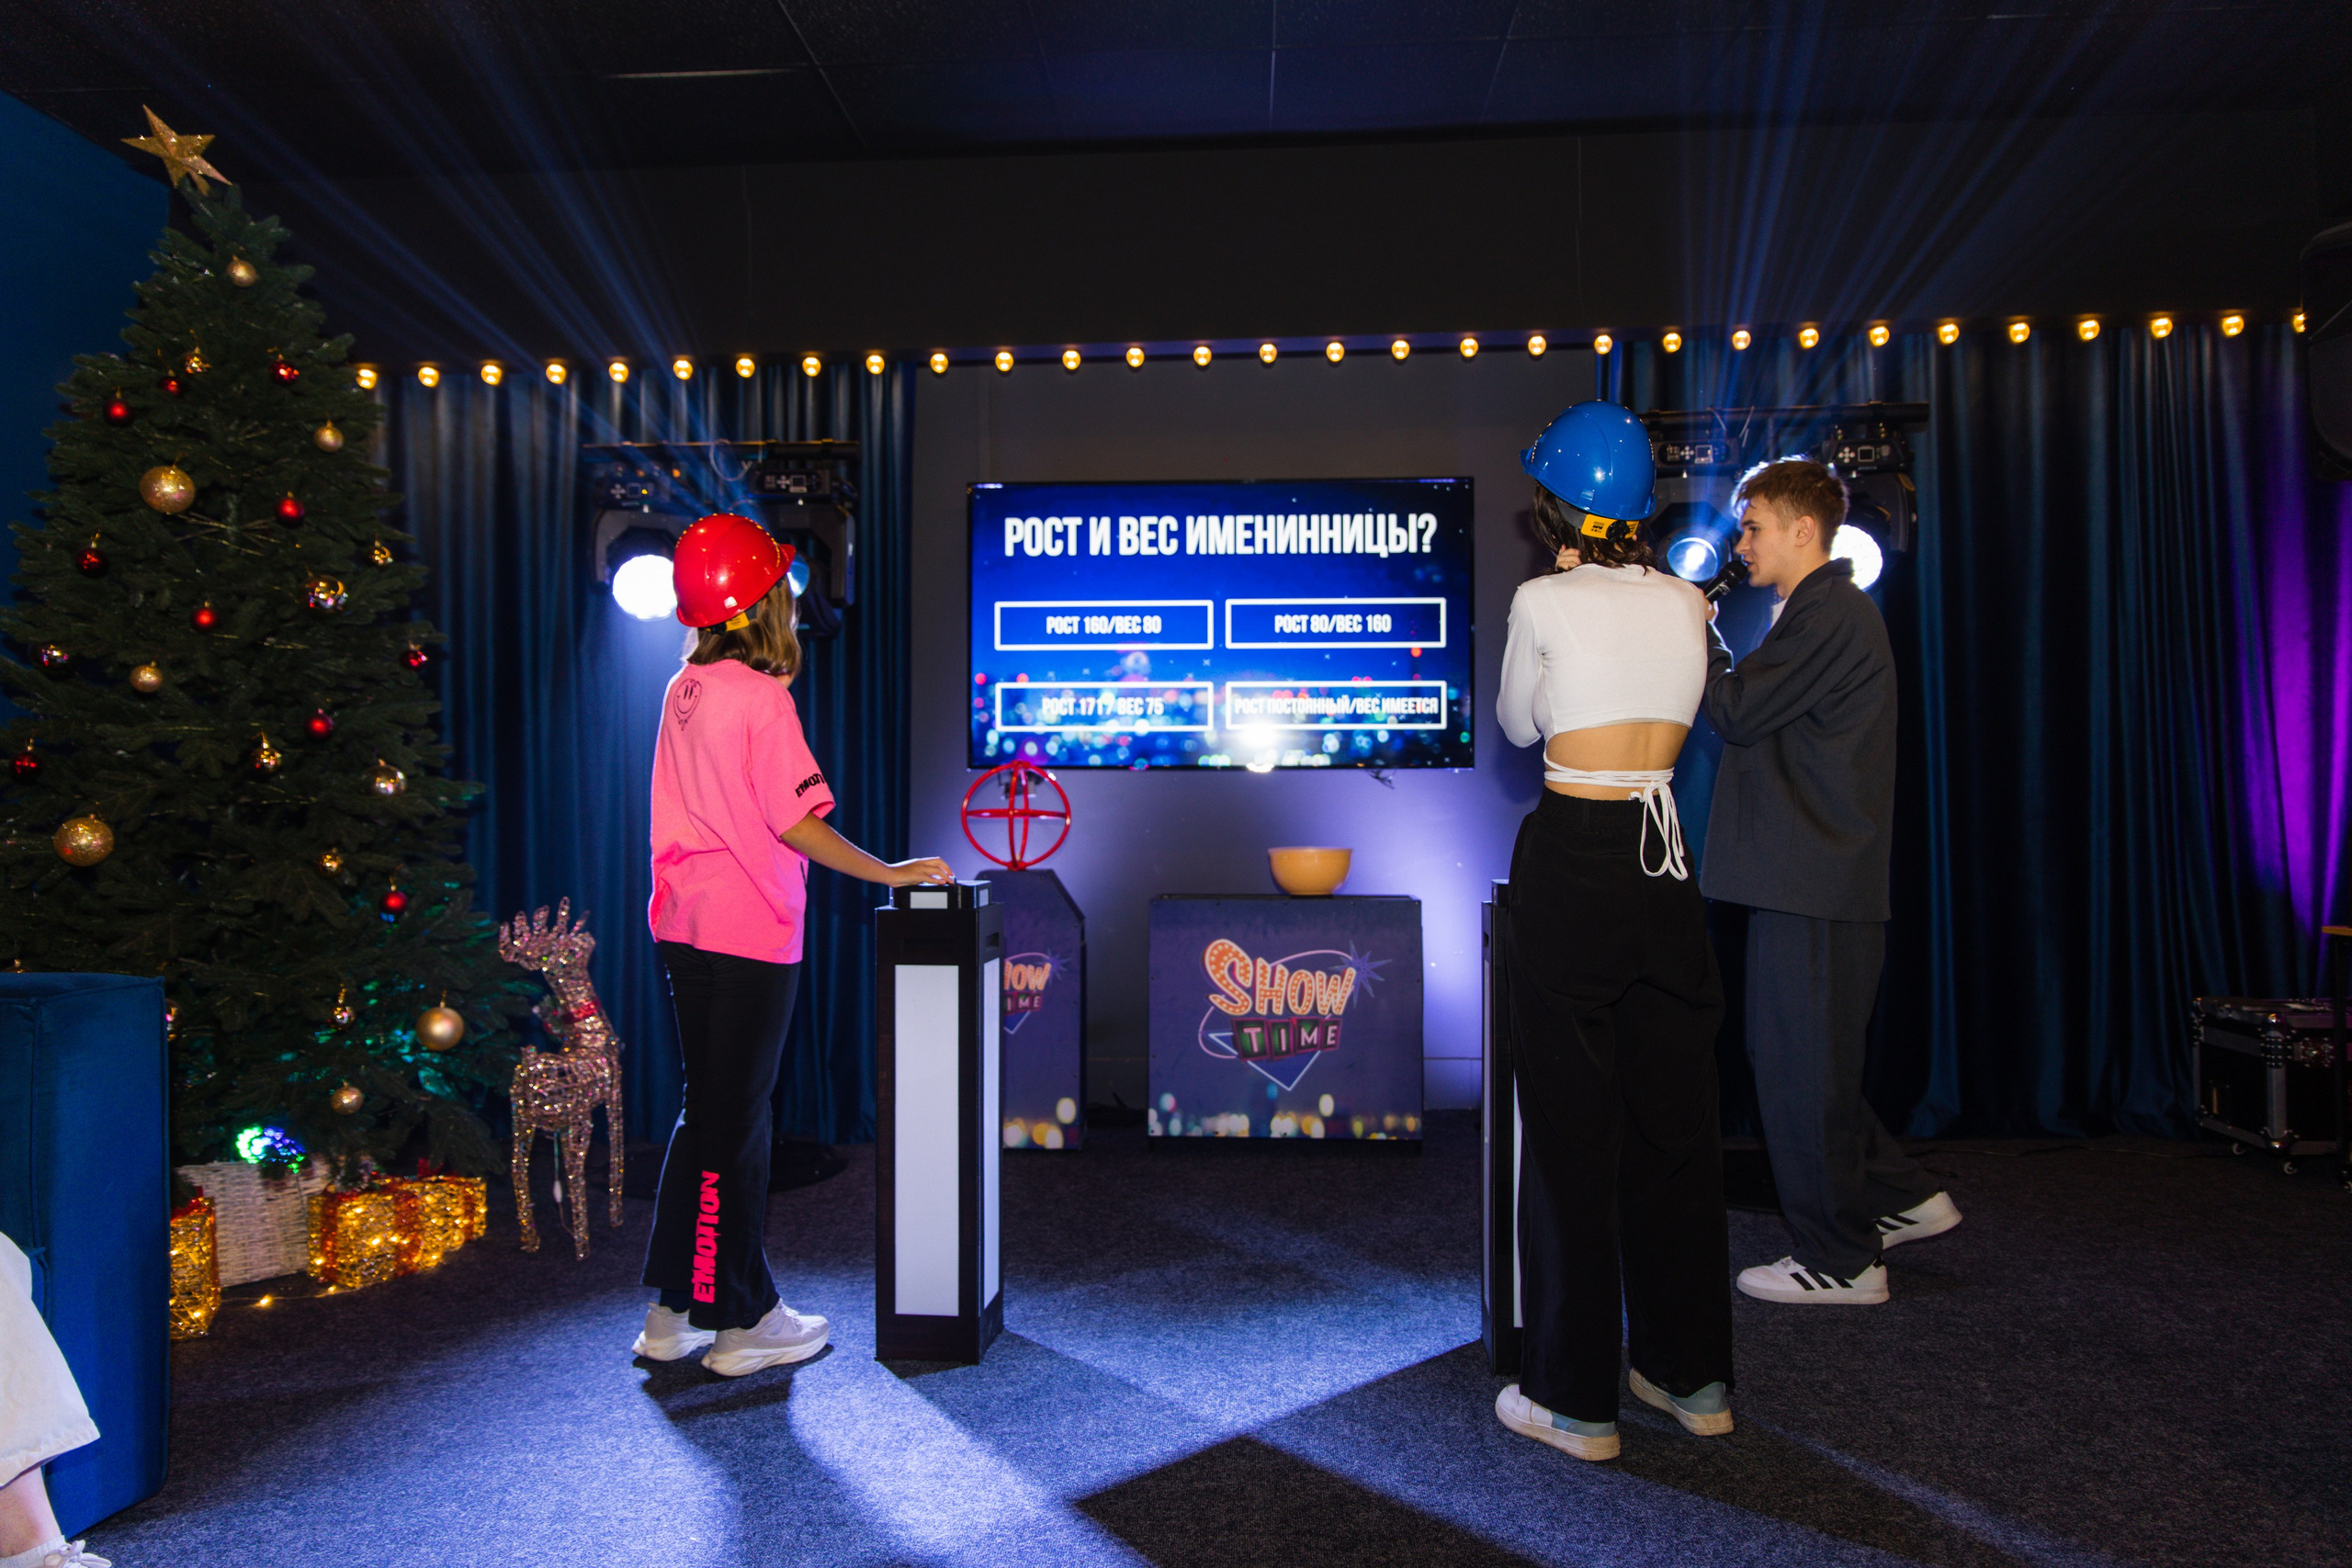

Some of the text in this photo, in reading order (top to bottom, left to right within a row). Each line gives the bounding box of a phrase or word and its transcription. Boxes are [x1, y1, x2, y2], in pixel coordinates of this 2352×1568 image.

[1004, 513, 1438, 558] РОСТ И ВЕС ИМЕНИННИЦЫ?
[1046, 615, 1162, 635] РОСТ 160/ВЕС 80
[1274, 614, 1392, 634] РОСТ 80/ВЕС 160
[1042, 697, 1076, 716] РОСТ
[1117, 697, 1144, 716] ВЕС
[1145, 697, 1165, 716] 75
[1235, 697, 1265, 715] РОСТ
[1382, 697, 1439, 715] ИМЕЕТСЯ
[1003, 960, 1052, 991] OW
[1204, 938, 1357, 1016] SHOW
[1006, 995, 1041, 1011] IME
[1243, 1025, 1338, 1053] TIME
[691, 1170, 721, 1303] EMOTION
